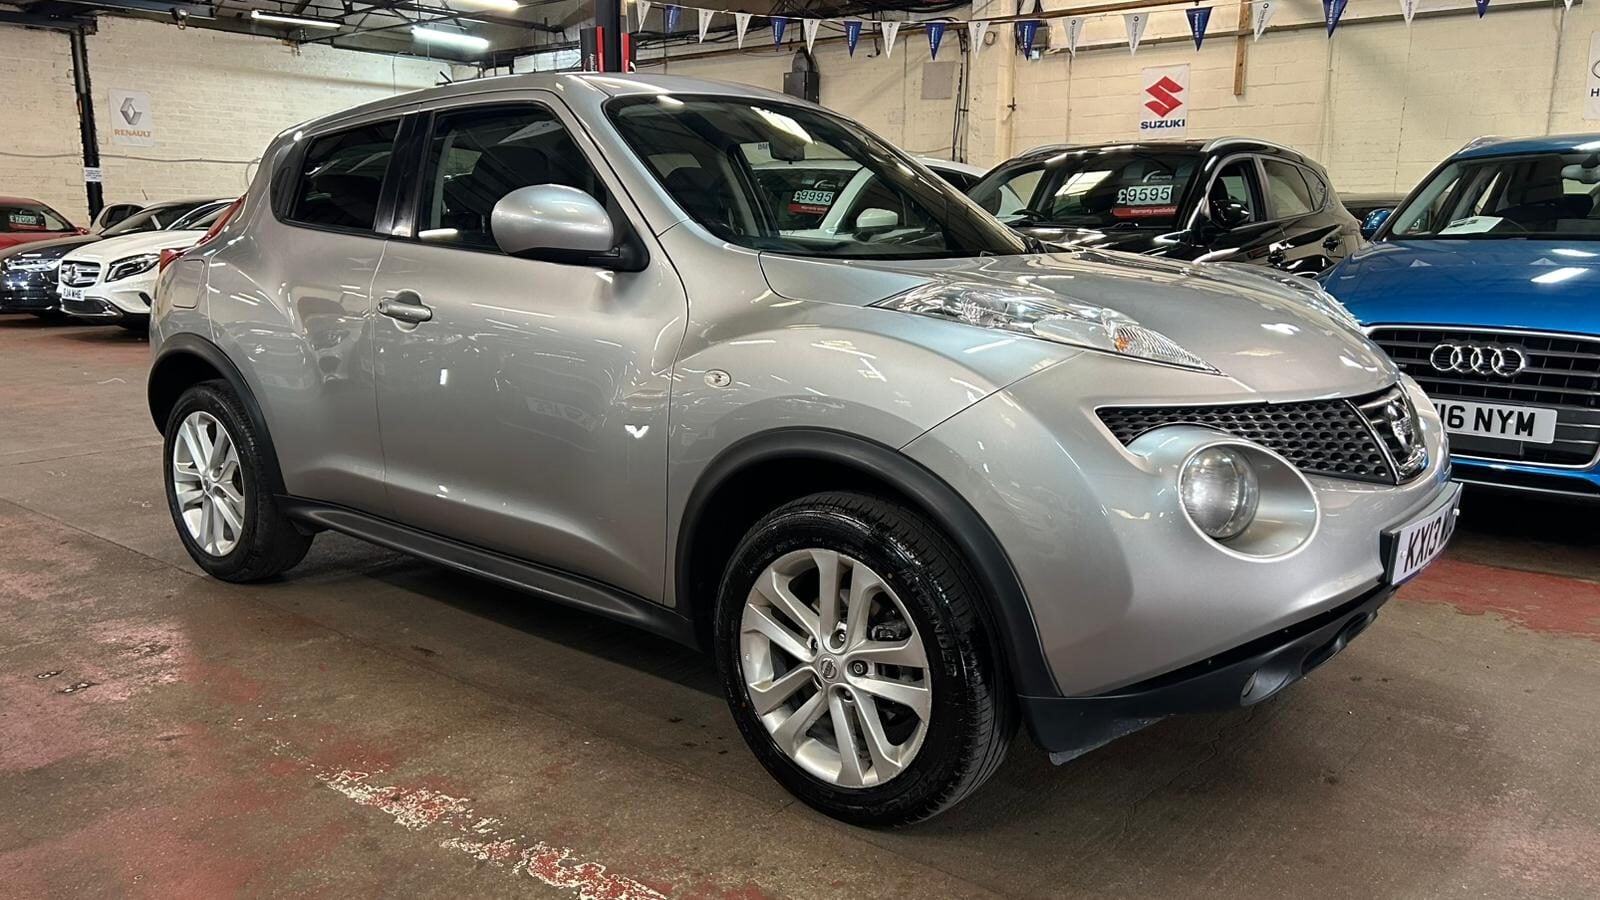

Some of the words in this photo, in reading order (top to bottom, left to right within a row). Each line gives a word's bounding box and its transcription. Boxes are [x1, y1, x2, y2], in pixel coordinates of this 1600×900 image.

[1140, 119, 1186, 130] SUZUKI
[114, 128, 152, 138] RENAULT
[793, 190, 833, 203] £9995
[1116, 186, 1171, 204] £9595
[1433, 403, 1466, 429] 16
[1473, 407, 1535, 437] NYM
[1403, 516, 1442, 574] KX13
